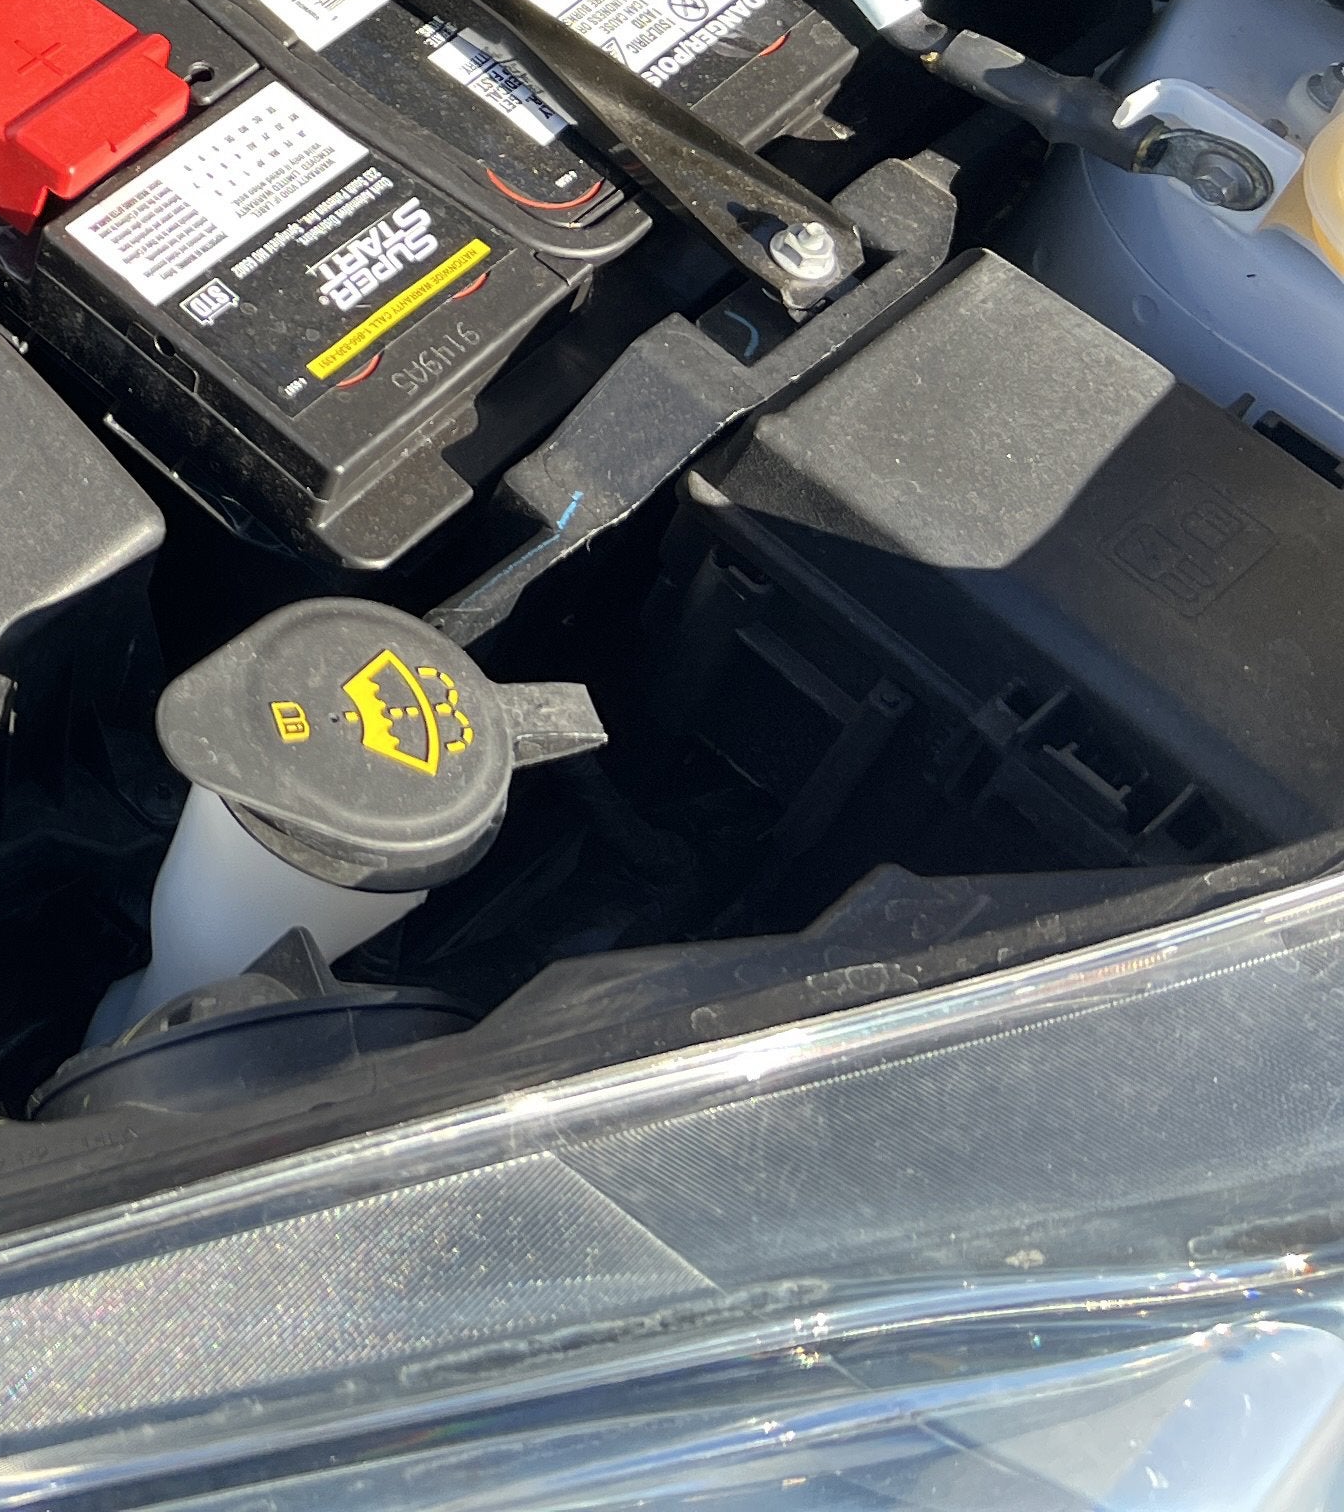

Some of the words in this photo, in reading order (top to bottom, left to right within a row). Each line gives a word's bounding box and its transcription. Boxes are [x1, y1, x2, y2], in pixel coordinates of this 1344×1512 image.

[622, 0, 643, 16] CAN
[630, 8, 657, 30] ACID
[598, 11, 628, 35] CAUSE
[624, 17, 672, 55] SULFURIC
[485, 74, 522, 104] EDICAL
[497, 93, 522, 113] GET
[287, 152, 306, 166] only
[302, 142, 322, 156] valid
[263, 167, 286, 183] dated
[270, 169, 301, 191] LIMITED
[295, 157, 336, 186] WARRANTY
[246, 180, 267, 195] when
[270, 194, 282, 204] IF
[277, 182, 299, 198] VOID
[233, 188, 274, 218] WARRANTY
[250, 200, 275, 218] LABEL
[260, 220, 305, 254] Springfield
[316, 195, 434, 294] START
[328, 225, 439, 312] SUPER
[429, 247, 478, 285] NATIONWIDE
[186, 282, 230, 318] STD
[389, 281, 433, 315] WARRANTY
[368, 310, 394, 331] CALL
[392, 321, 482, 396] 9149A5
